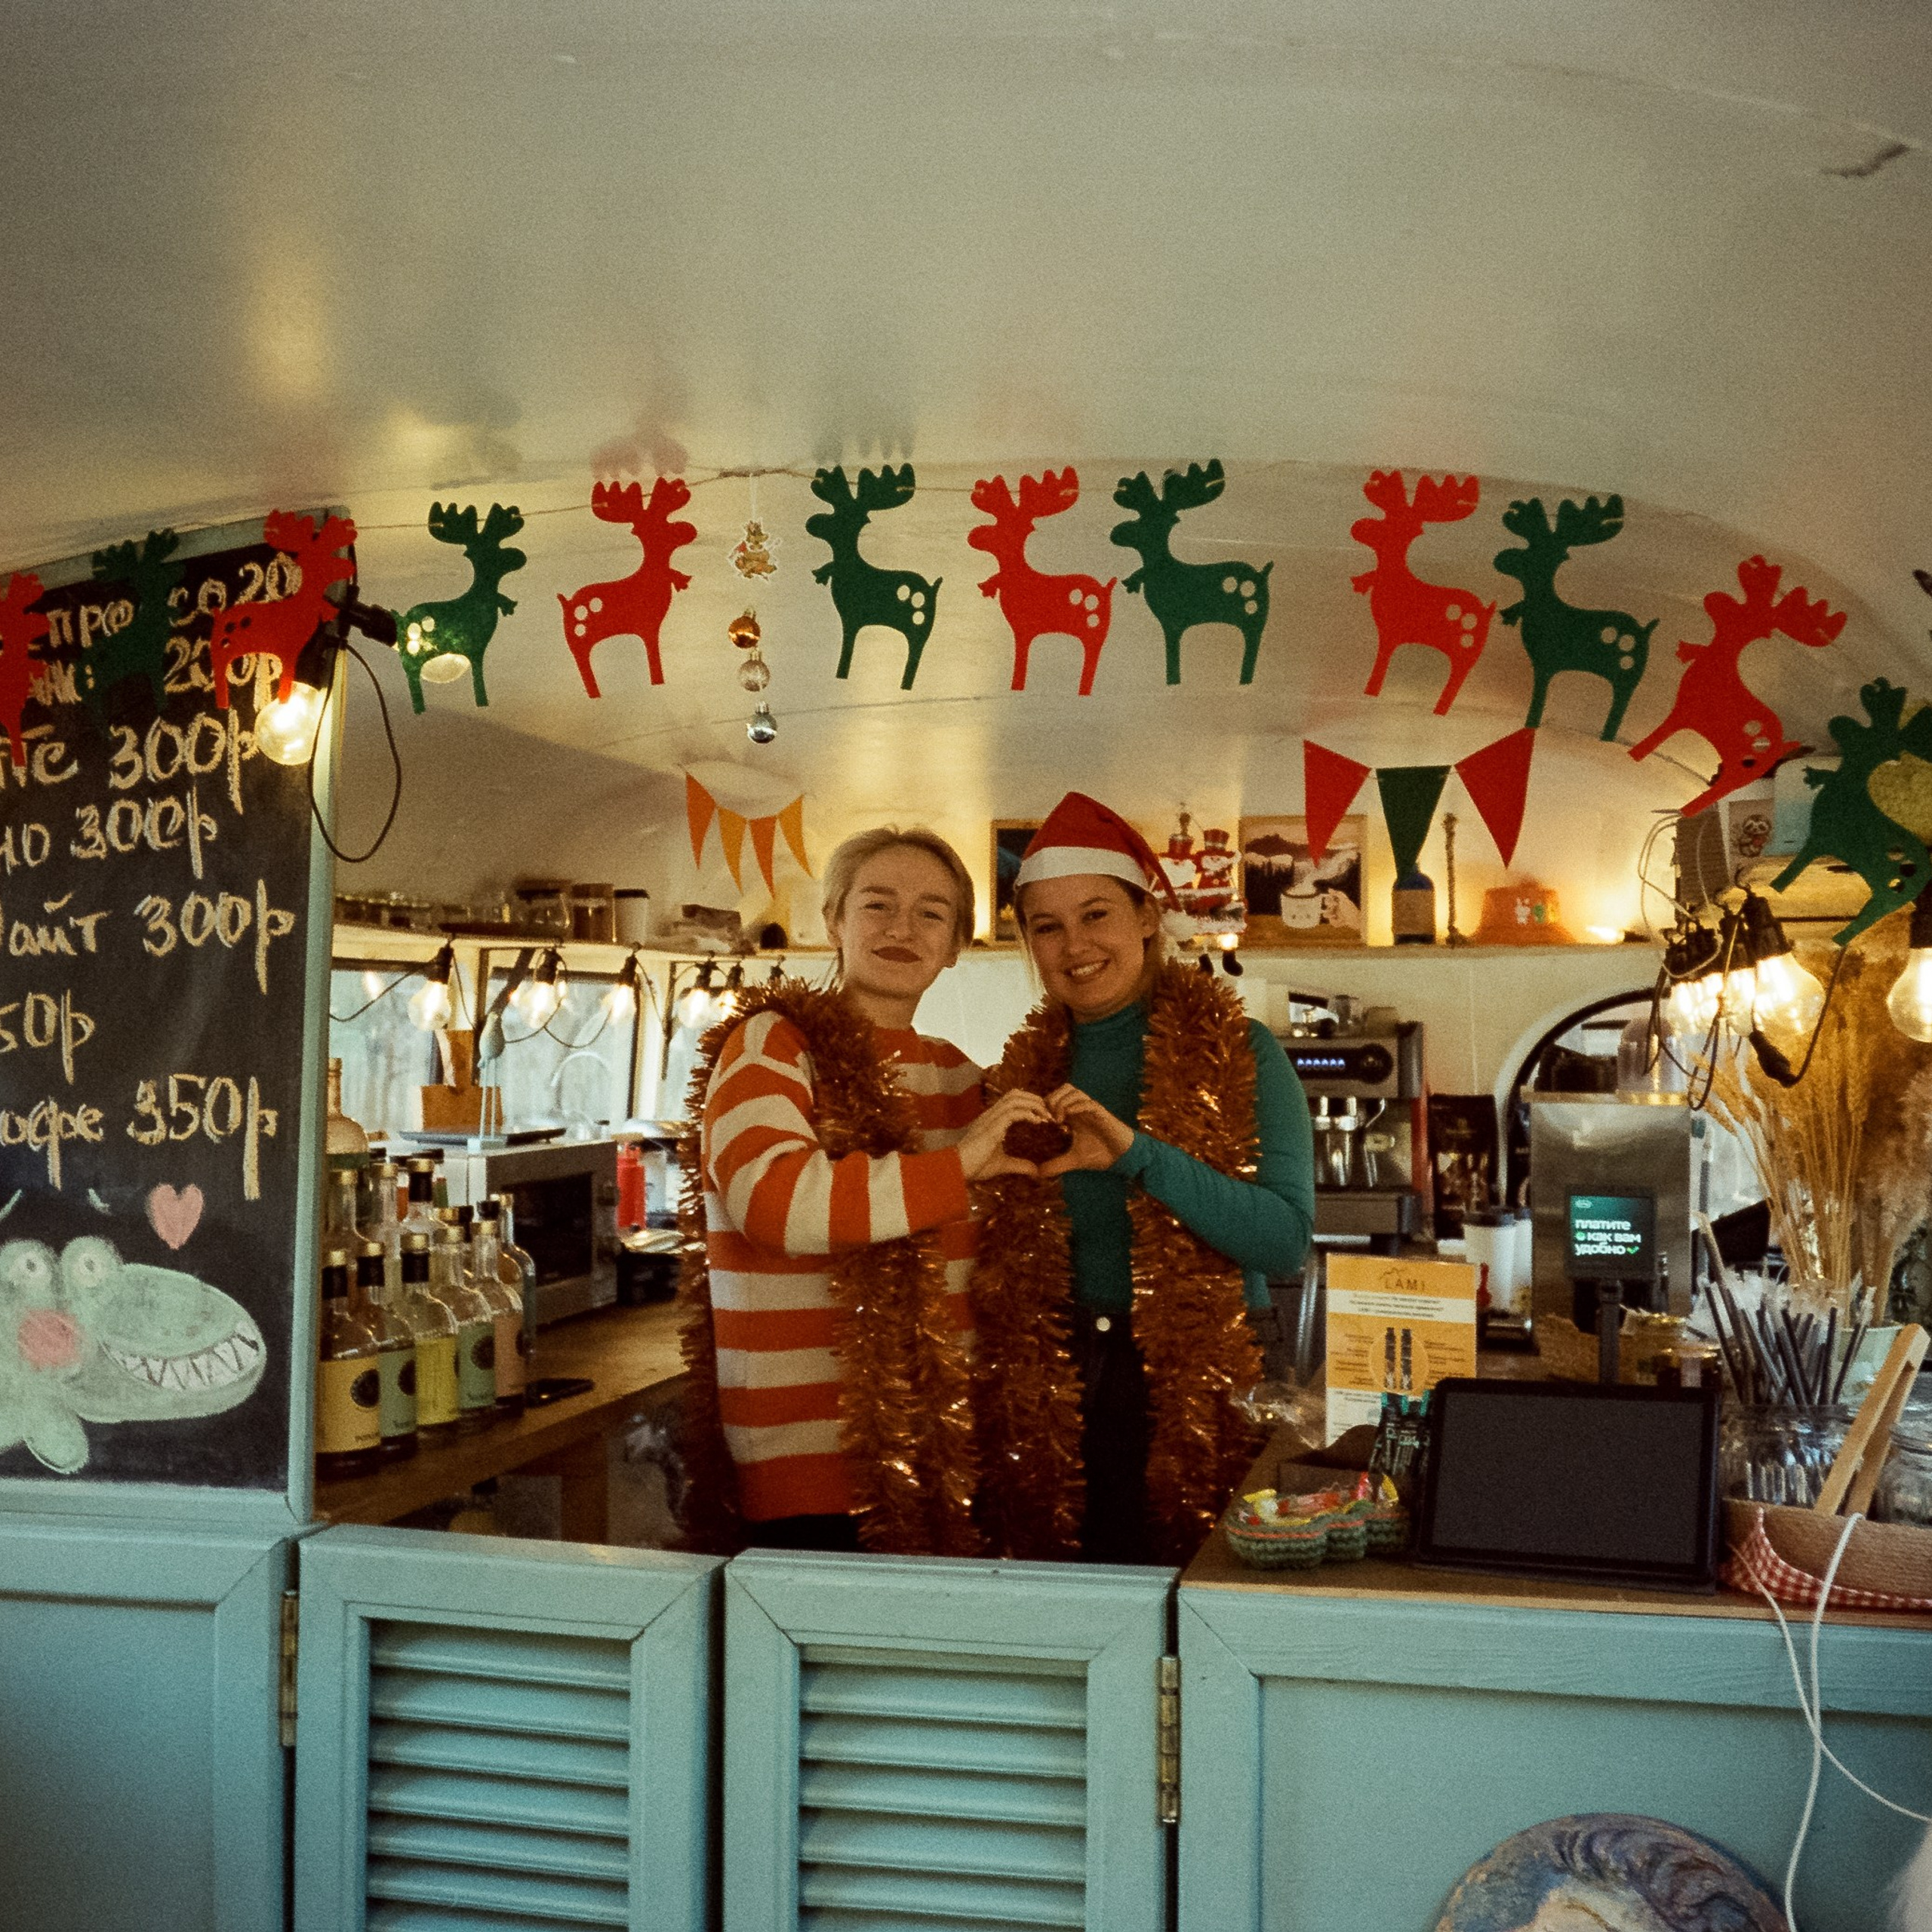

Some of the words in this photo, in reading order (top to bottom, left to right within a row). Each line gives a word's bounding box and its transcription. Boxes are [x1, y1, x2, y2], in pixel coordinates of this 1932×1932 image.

[109, 706, 260, 815] 300р
[70, 783, 217, 879] 300р
[0, 893, 112, 956] айт
[134, 879, 296, 995] 300р
[127, 1074, 278, 1201] 350р
[1574, 1241, 1626, 1256] удобно
[1575, 1220, 1631, 1230] платите
